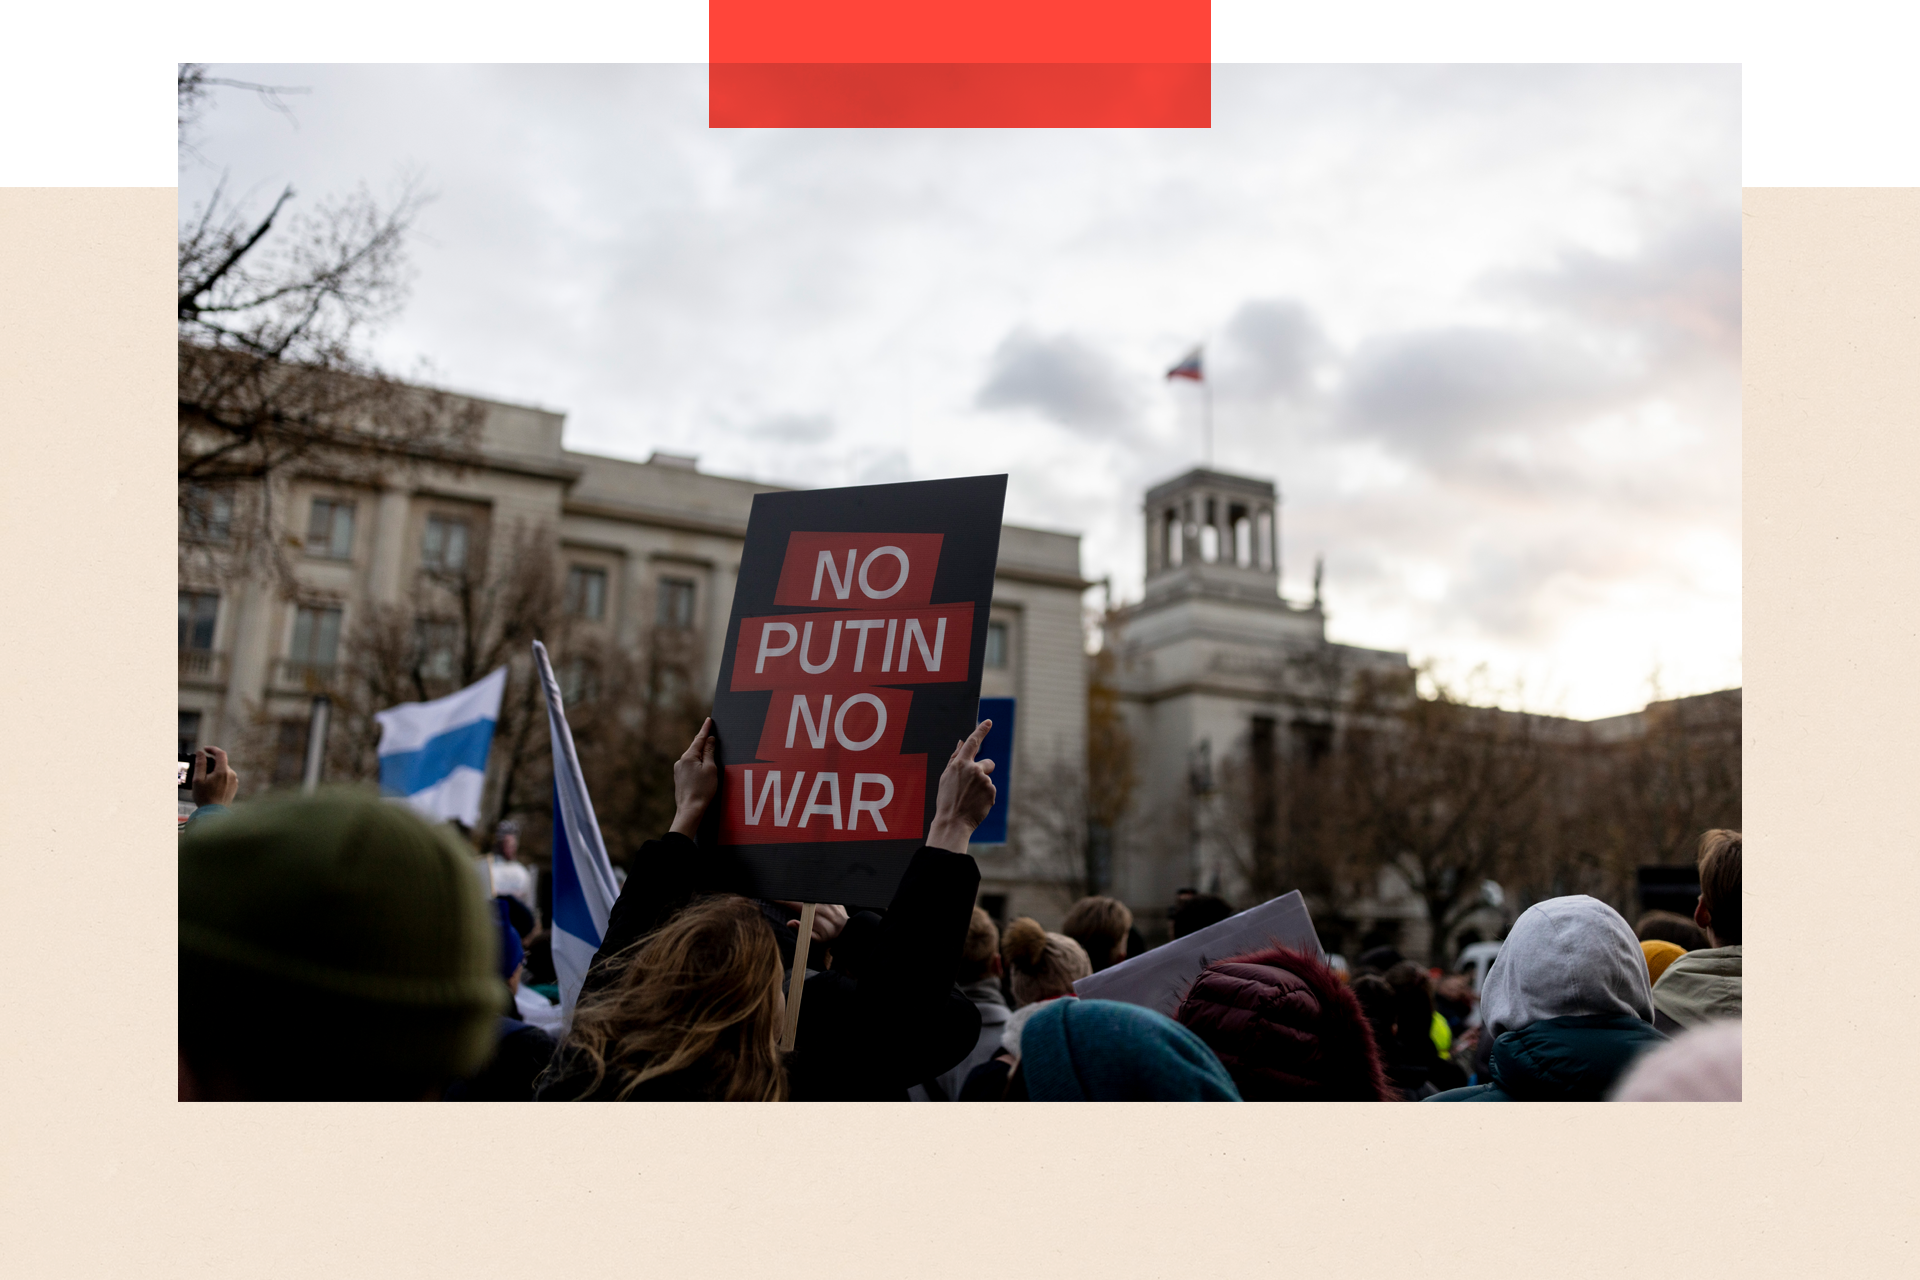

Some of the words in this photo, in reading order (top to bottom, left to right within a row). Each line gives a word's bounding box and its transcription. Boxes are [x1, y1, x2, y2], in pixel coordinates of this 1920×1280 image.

[810, 545, 910, 601] NO
[754, 617, 947, 675] PUTIN
[784, 692, 888, 752] NO
[743, 769, 895, 832] WAR
